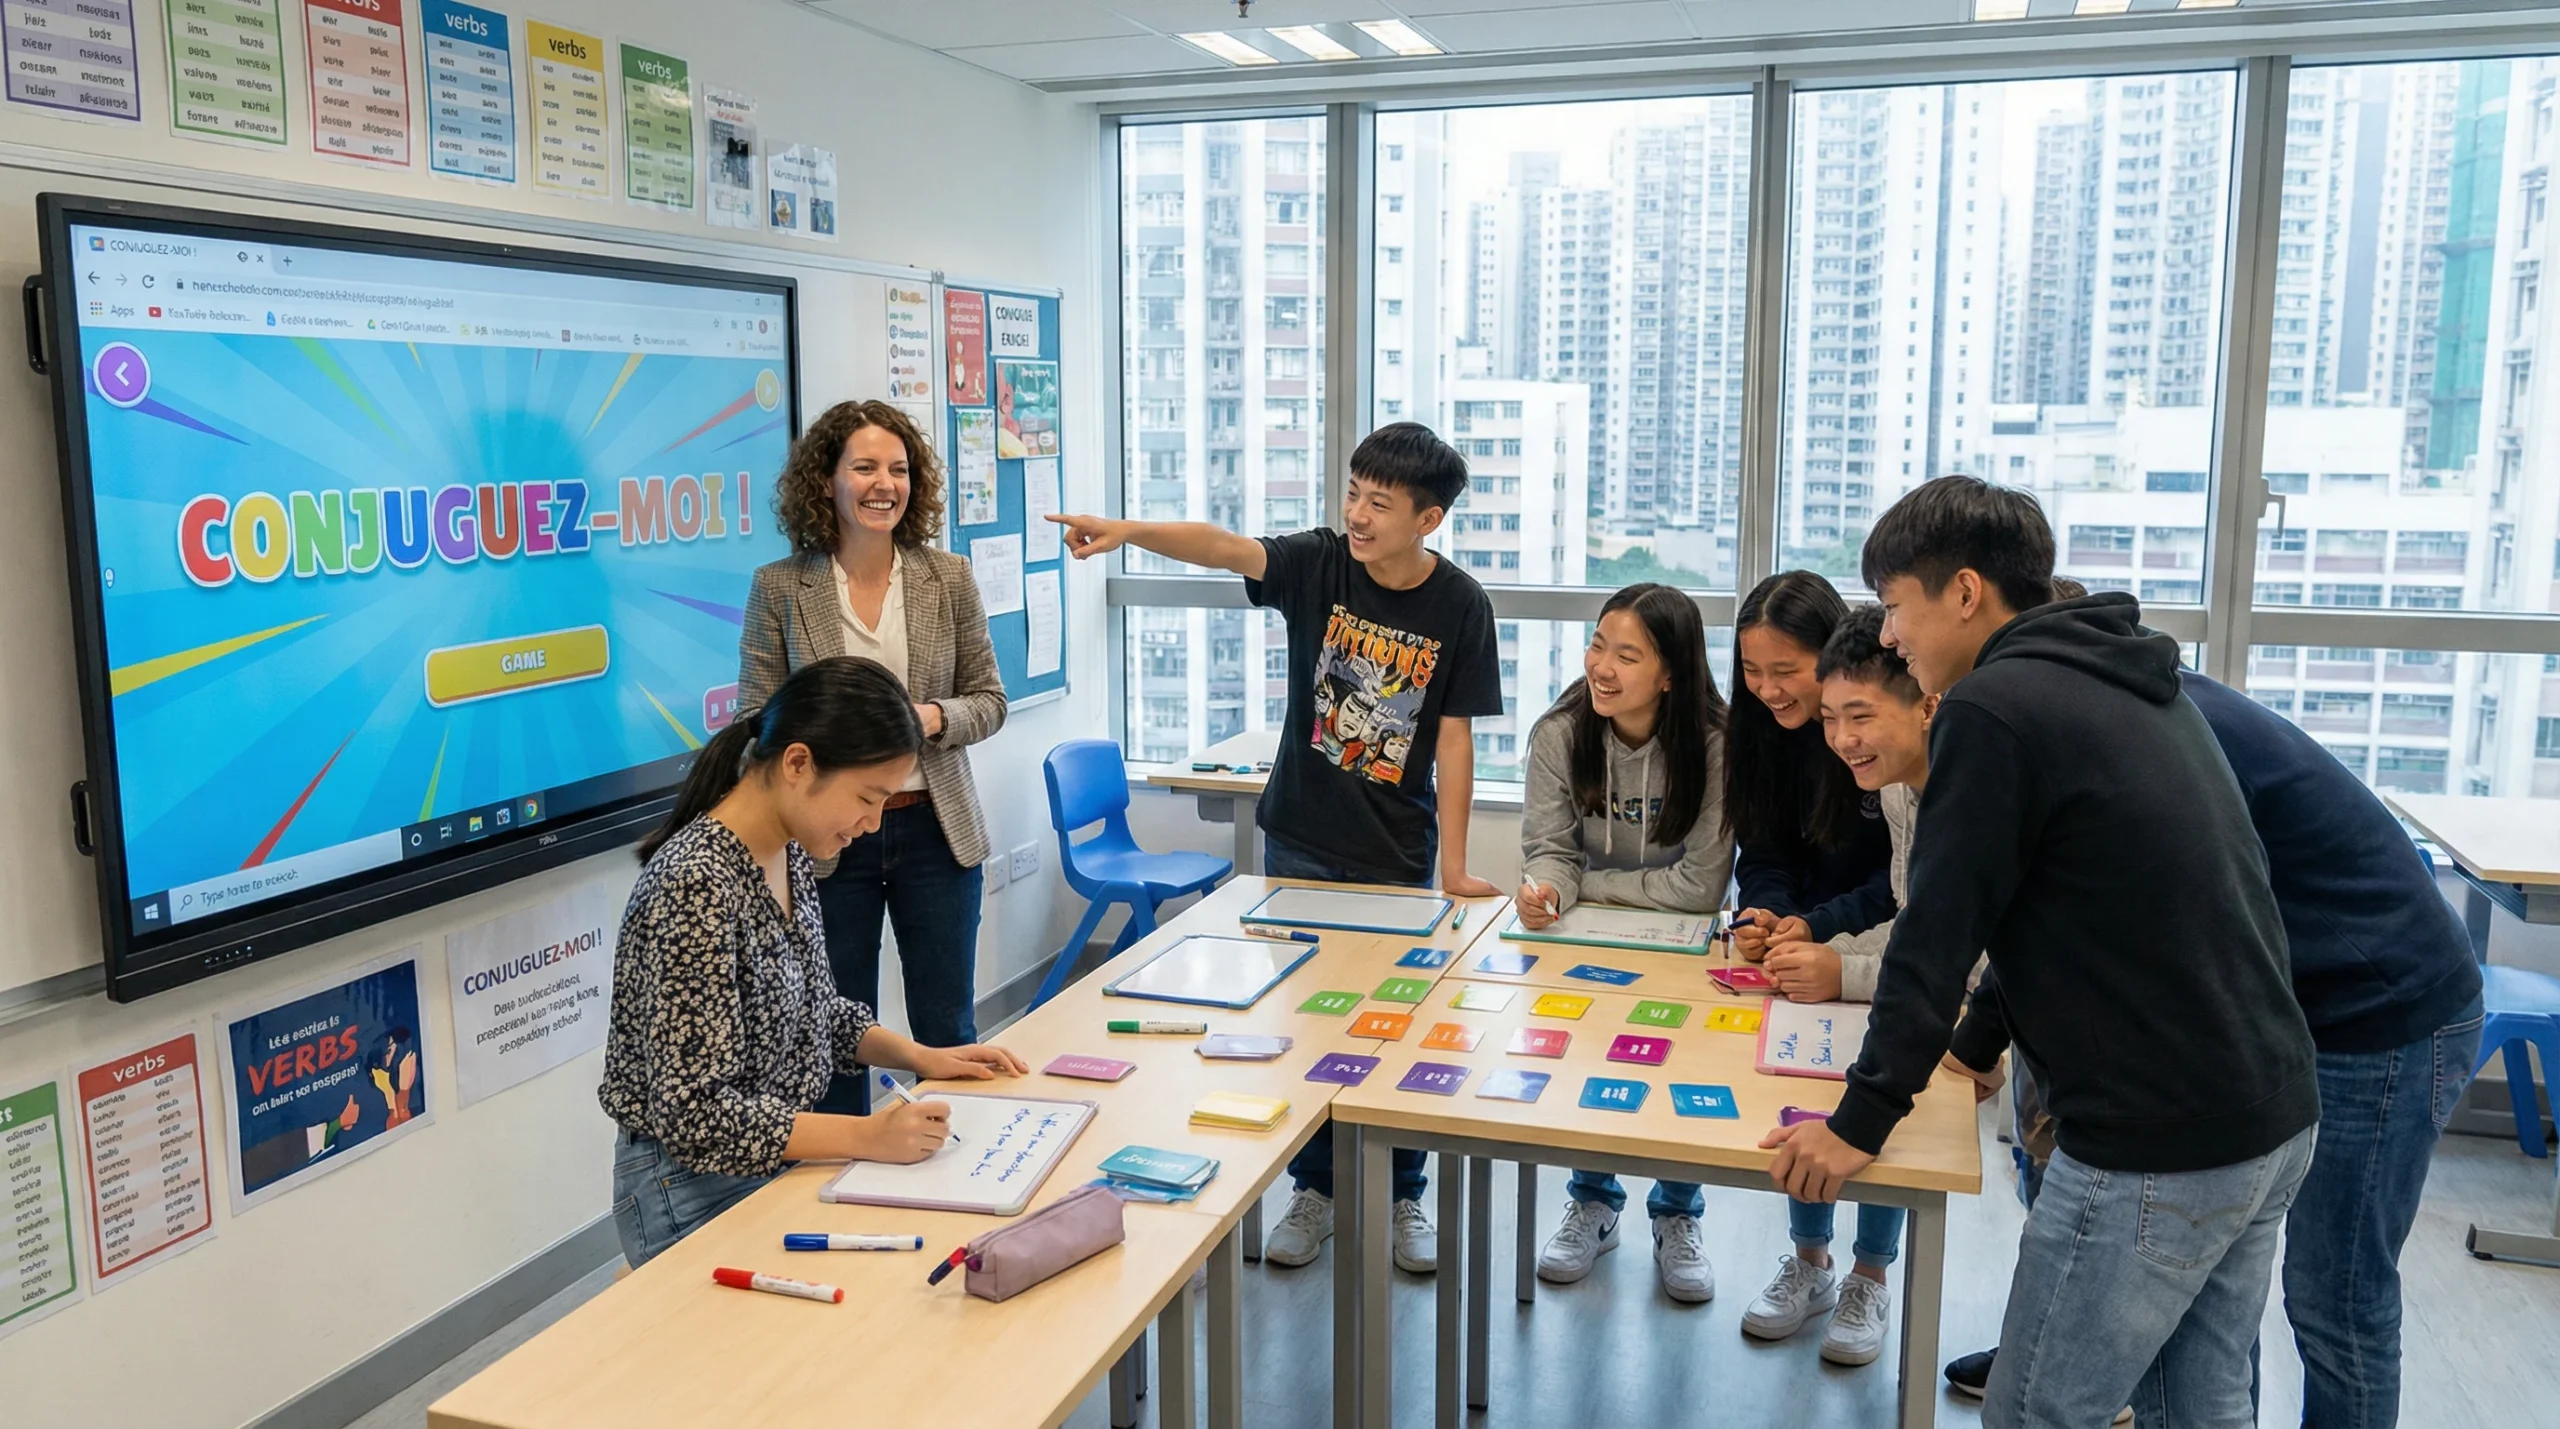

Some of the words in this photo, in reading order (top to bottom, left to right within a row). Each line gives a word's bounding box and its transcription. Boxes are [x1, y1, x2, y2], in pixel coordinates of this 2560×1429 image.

[445, 13, 488, 36] verbs
[549, 38, 587, 59] verbs
[638, 59, 672, 80] verbs
[110, 305, 135, 318] Apps
[178, 472, 727, 588] CONJUGUEZ-MOI
[501, 650, 546, 674] GAME
[113, 1054, 166, 1083] verbs
[248, 1024, 358, 1096] VERBS
